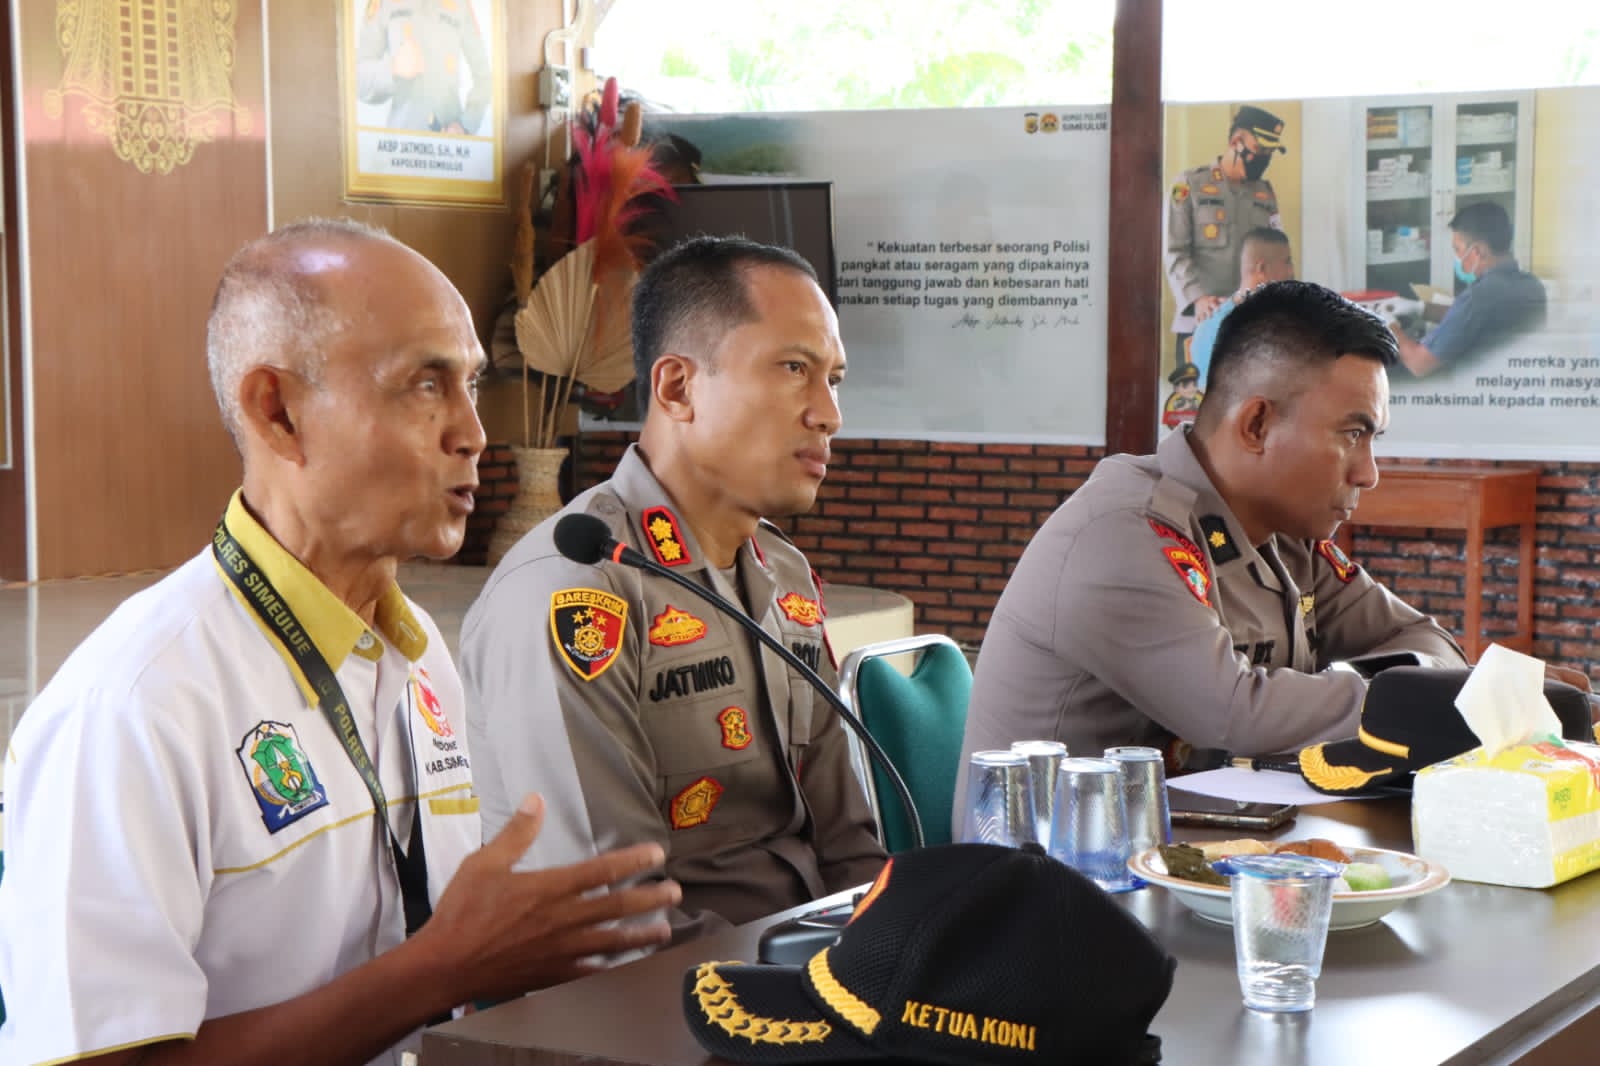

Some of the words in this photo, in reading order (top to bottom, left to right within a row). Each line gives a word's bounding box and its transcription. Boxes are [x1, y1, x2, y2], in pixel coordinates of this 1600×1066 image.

[877, 241, 936, 253] Kekuatan
[939, 241, 992, 253] terbesar
[996, 243, 1049, 256] seorang
[1053, 240, 1090, 253] Polisi
[841, 260, 890, 273] pangkat
[894, 260, 920, 271] atau
[925, 262, 979, 273] seragam
[983, 262, 1014, 274] yang
[1018, 259, 1089, 273] dipakainya
[862, 277, 921, 290] tanggung
[924, 276, 962, 290] jawab
[965, 276, 989, 288] dan
[993, 276, 1060, 289] kebesaran
[1064, 276, 1089, 288] hati
[882, 293, 920, 308] setiap
[924, 295, 959, 309] tugas
[962, 295, 994, 309] yang
[1508, 355, 1565, 368] mereka
[1475, 374, 1545, 390] melayani
[1411, 393, 1484, 405] maksimal
[1489, 393, 1544, 408] kepada
[1549, 394, 1600, 407] merek
[244, 572, 311, 656] SIMEULUE
[649, 655, 735, 702] JATMIKO
[334, 703, 368, 769] POLRES
[901, 1000, 978, 1040] KETUA
[981, 1016, 1036, 1051] KONI
